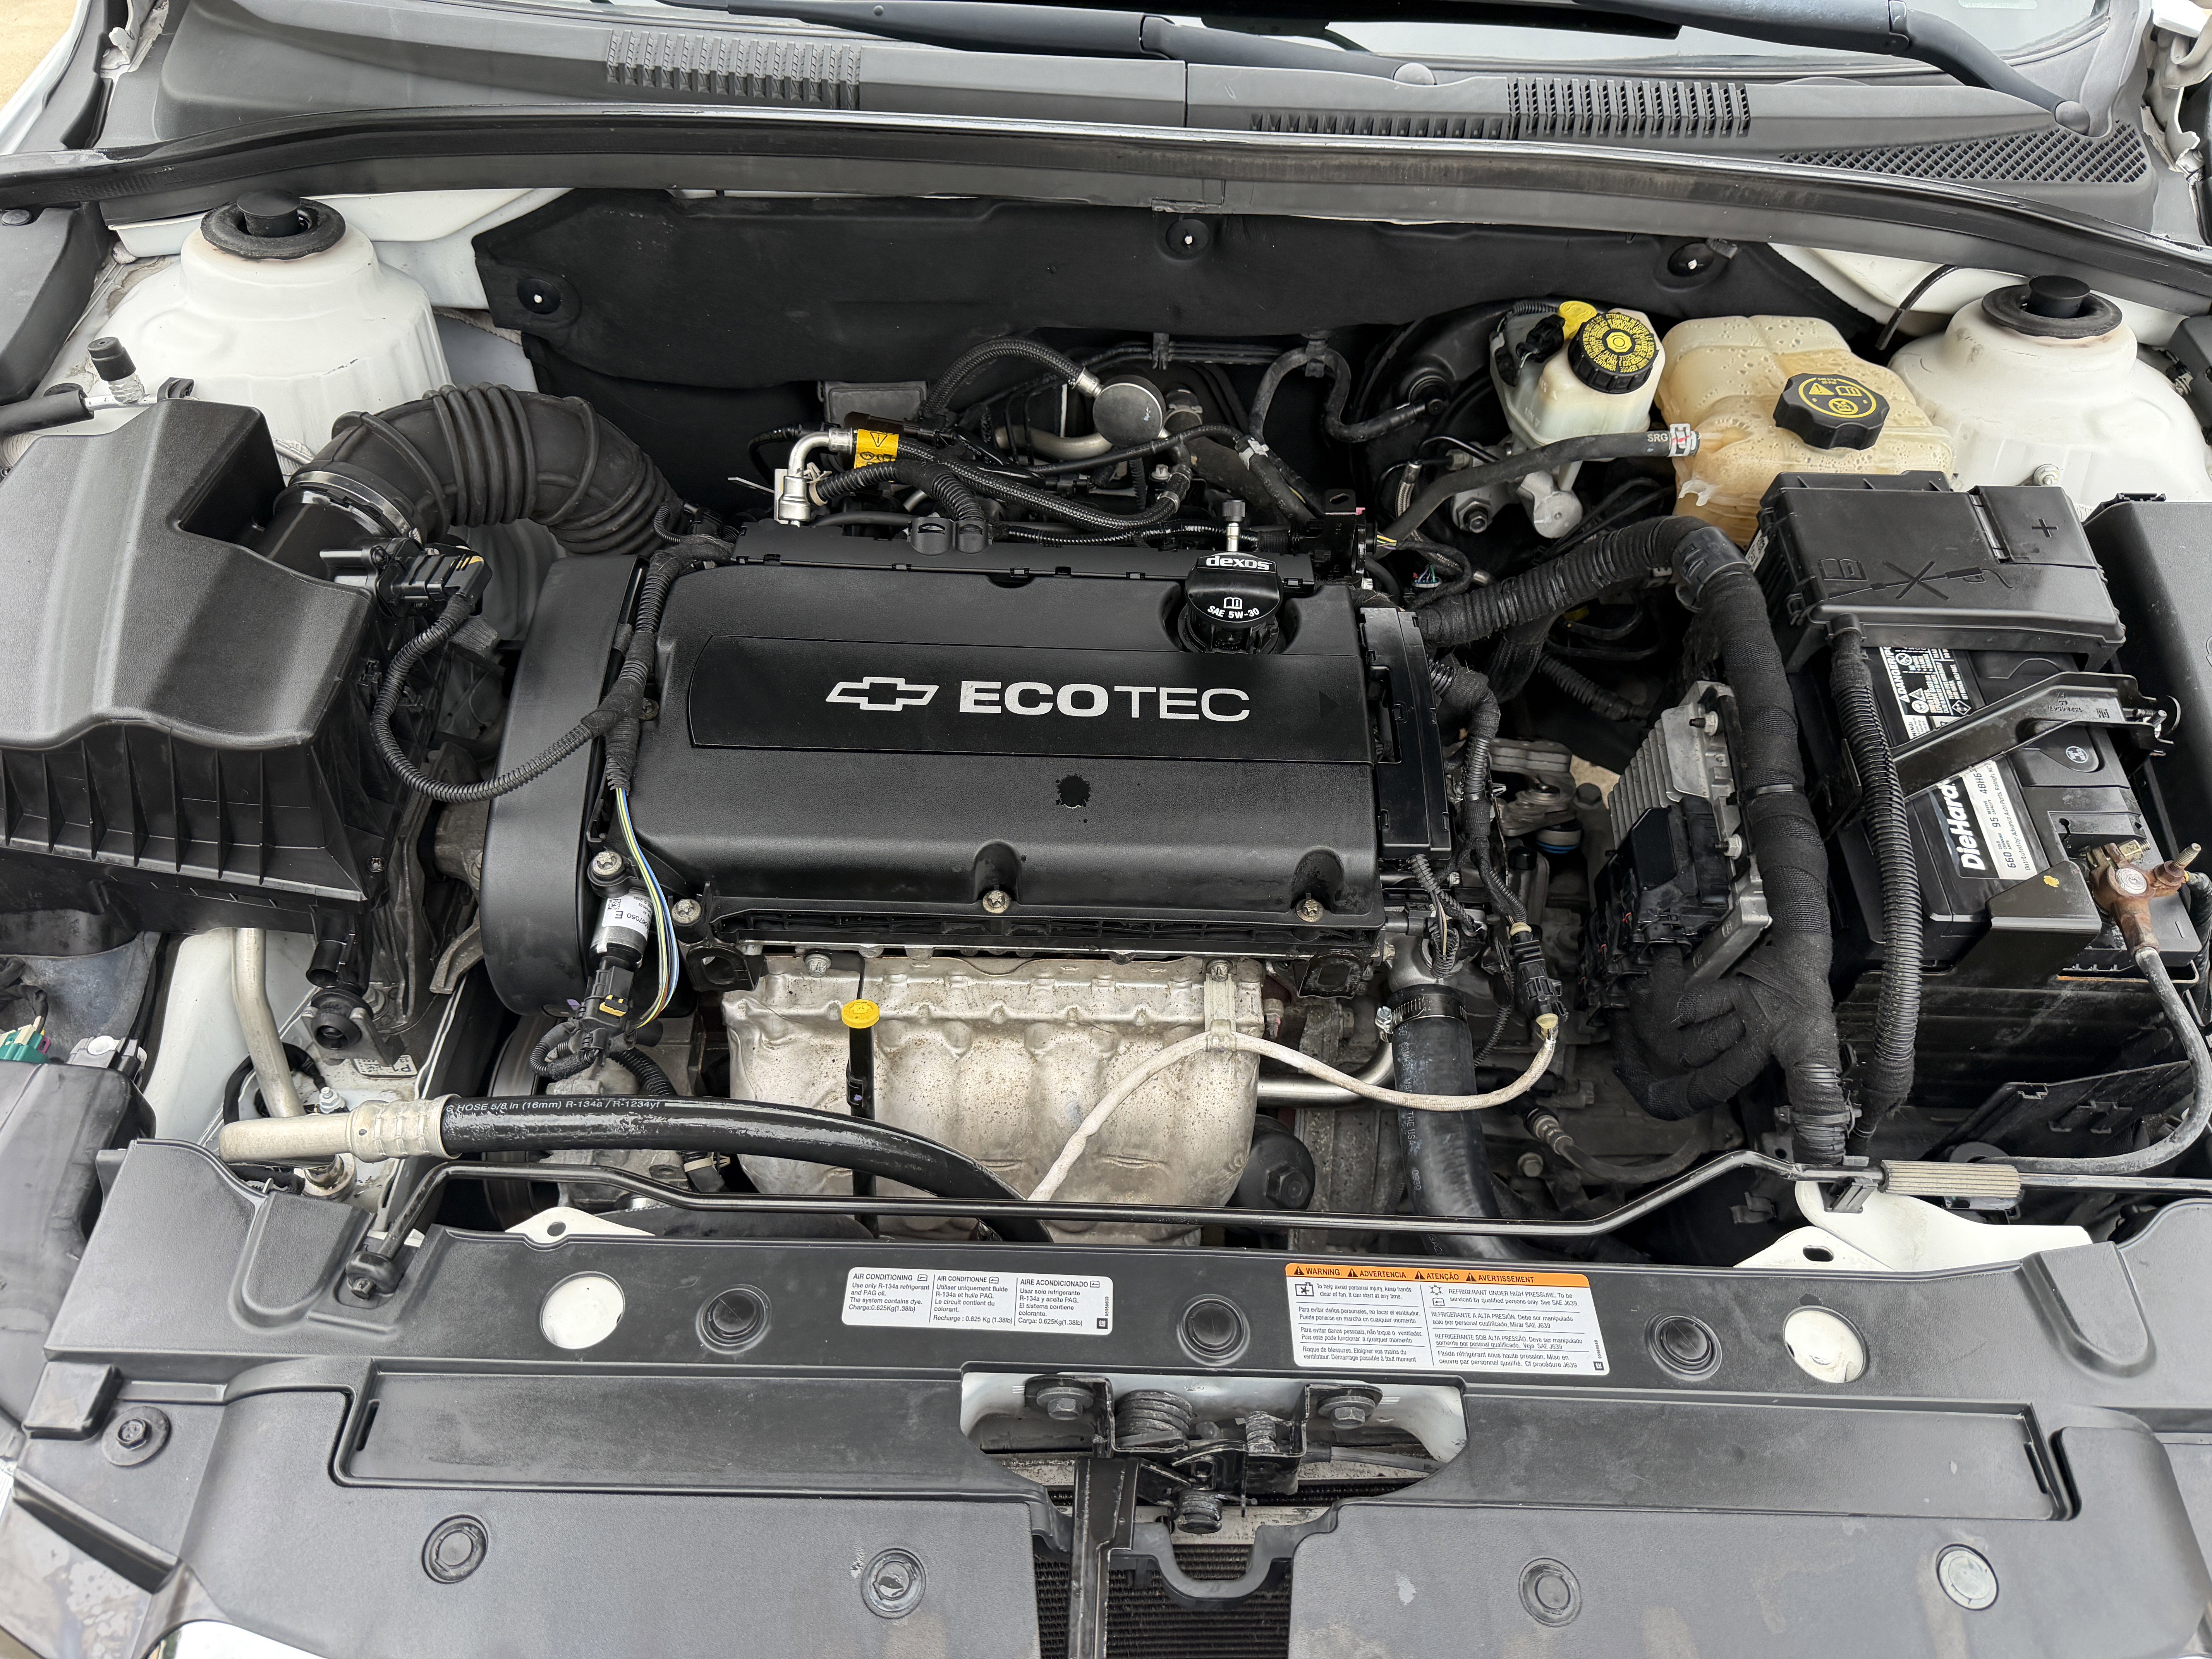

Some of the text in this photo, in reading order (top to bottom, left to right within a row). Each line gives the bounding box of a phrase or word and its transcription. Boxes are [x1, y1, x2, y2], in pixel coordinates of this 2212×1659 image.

[1647, 433, 1668, 442] SRG
[1206, 555, 1269, 570] dexos
[1207, 605, 1260, 618] SAE 5W-30
[960, 680, 1250, 722] ECOTEC
[1973, 768, 1987, 794] 48H6-
[1938, 784, 1985, 870] DieHard
[1990, 817, 2001, 827] 95
[2008, 819, 2018, 836] Advance
[2003, 852, 2016, 868] 660
[2018, 847, 2031, 871] Distributed
[615, 910, 623, 919] E
[457, 1103, 489, 1111] HOSE
[491, 1103, 507, 1111] 5/8
[522, 1101, 562, 1110] (16mm)
[613, 1100, 661, 1109] R-1234yf
[1408, 1128, 1417, 1146] USA
[1306, 1267, 1340, 1276] WARNING
[1360, 1270, 1407, 1278] ADVERTENCIA
[1426, 1272, 1459, 1281] ATENÇÃO
[1478, 1275, 1534, 1283] AVERTISSEMENT
